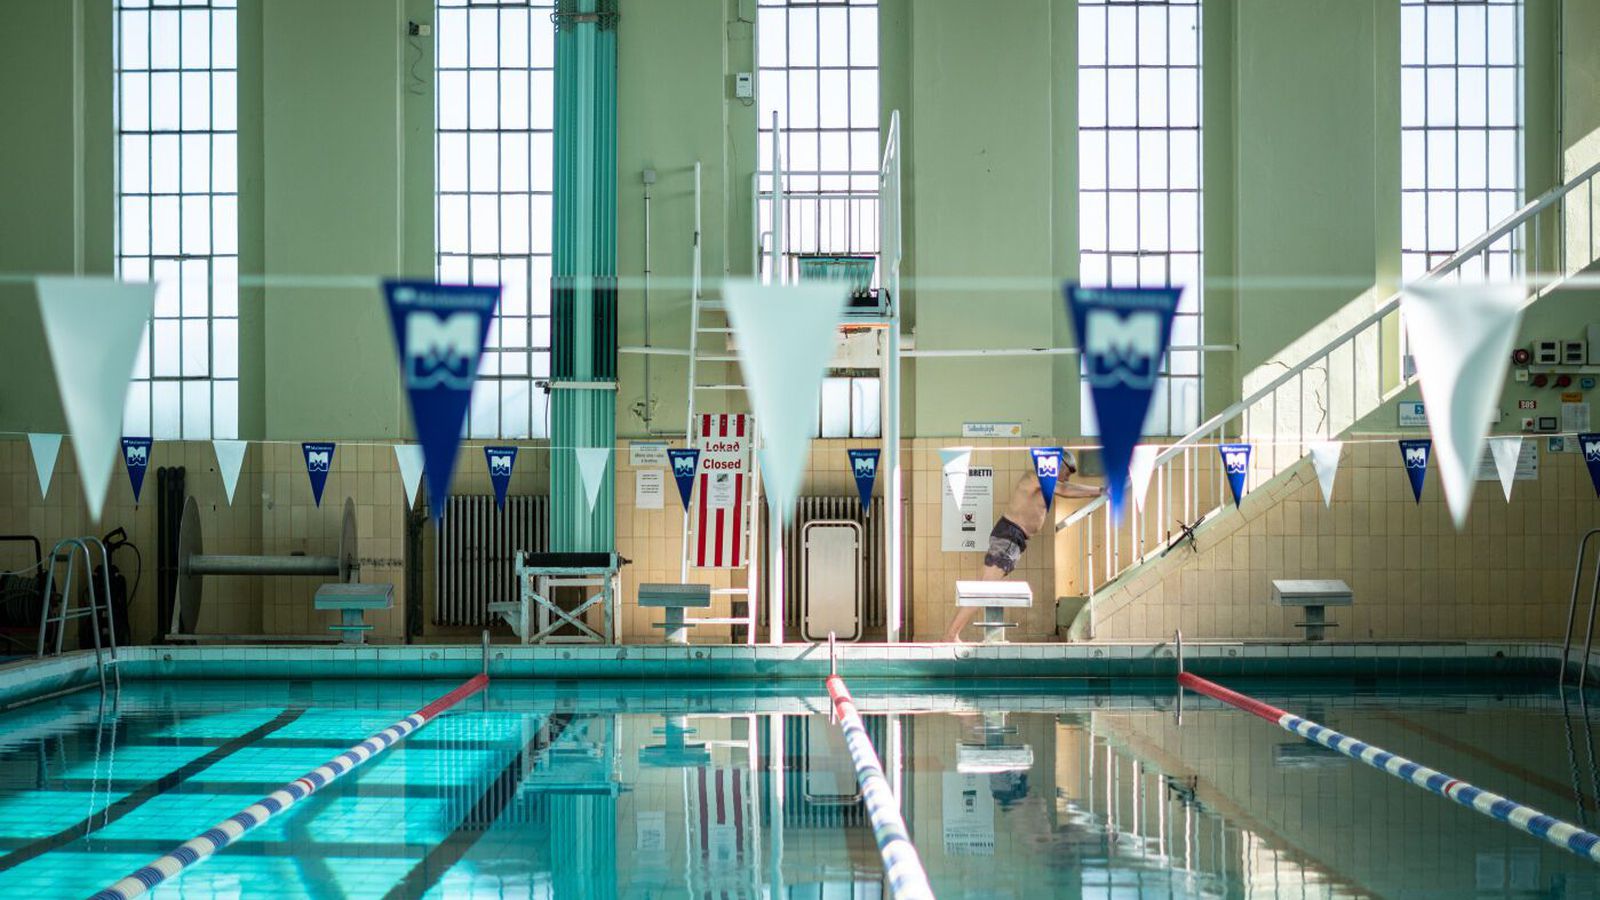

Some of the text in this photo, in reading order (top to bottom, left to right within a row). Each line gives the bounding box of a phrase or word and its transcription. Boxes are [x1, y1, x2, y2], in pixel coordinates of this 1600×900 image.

[1520, 400, 1535, 409] SOS
[706, 441, 740, 452] Lokað
[703, 458, 741, 470] Closed
